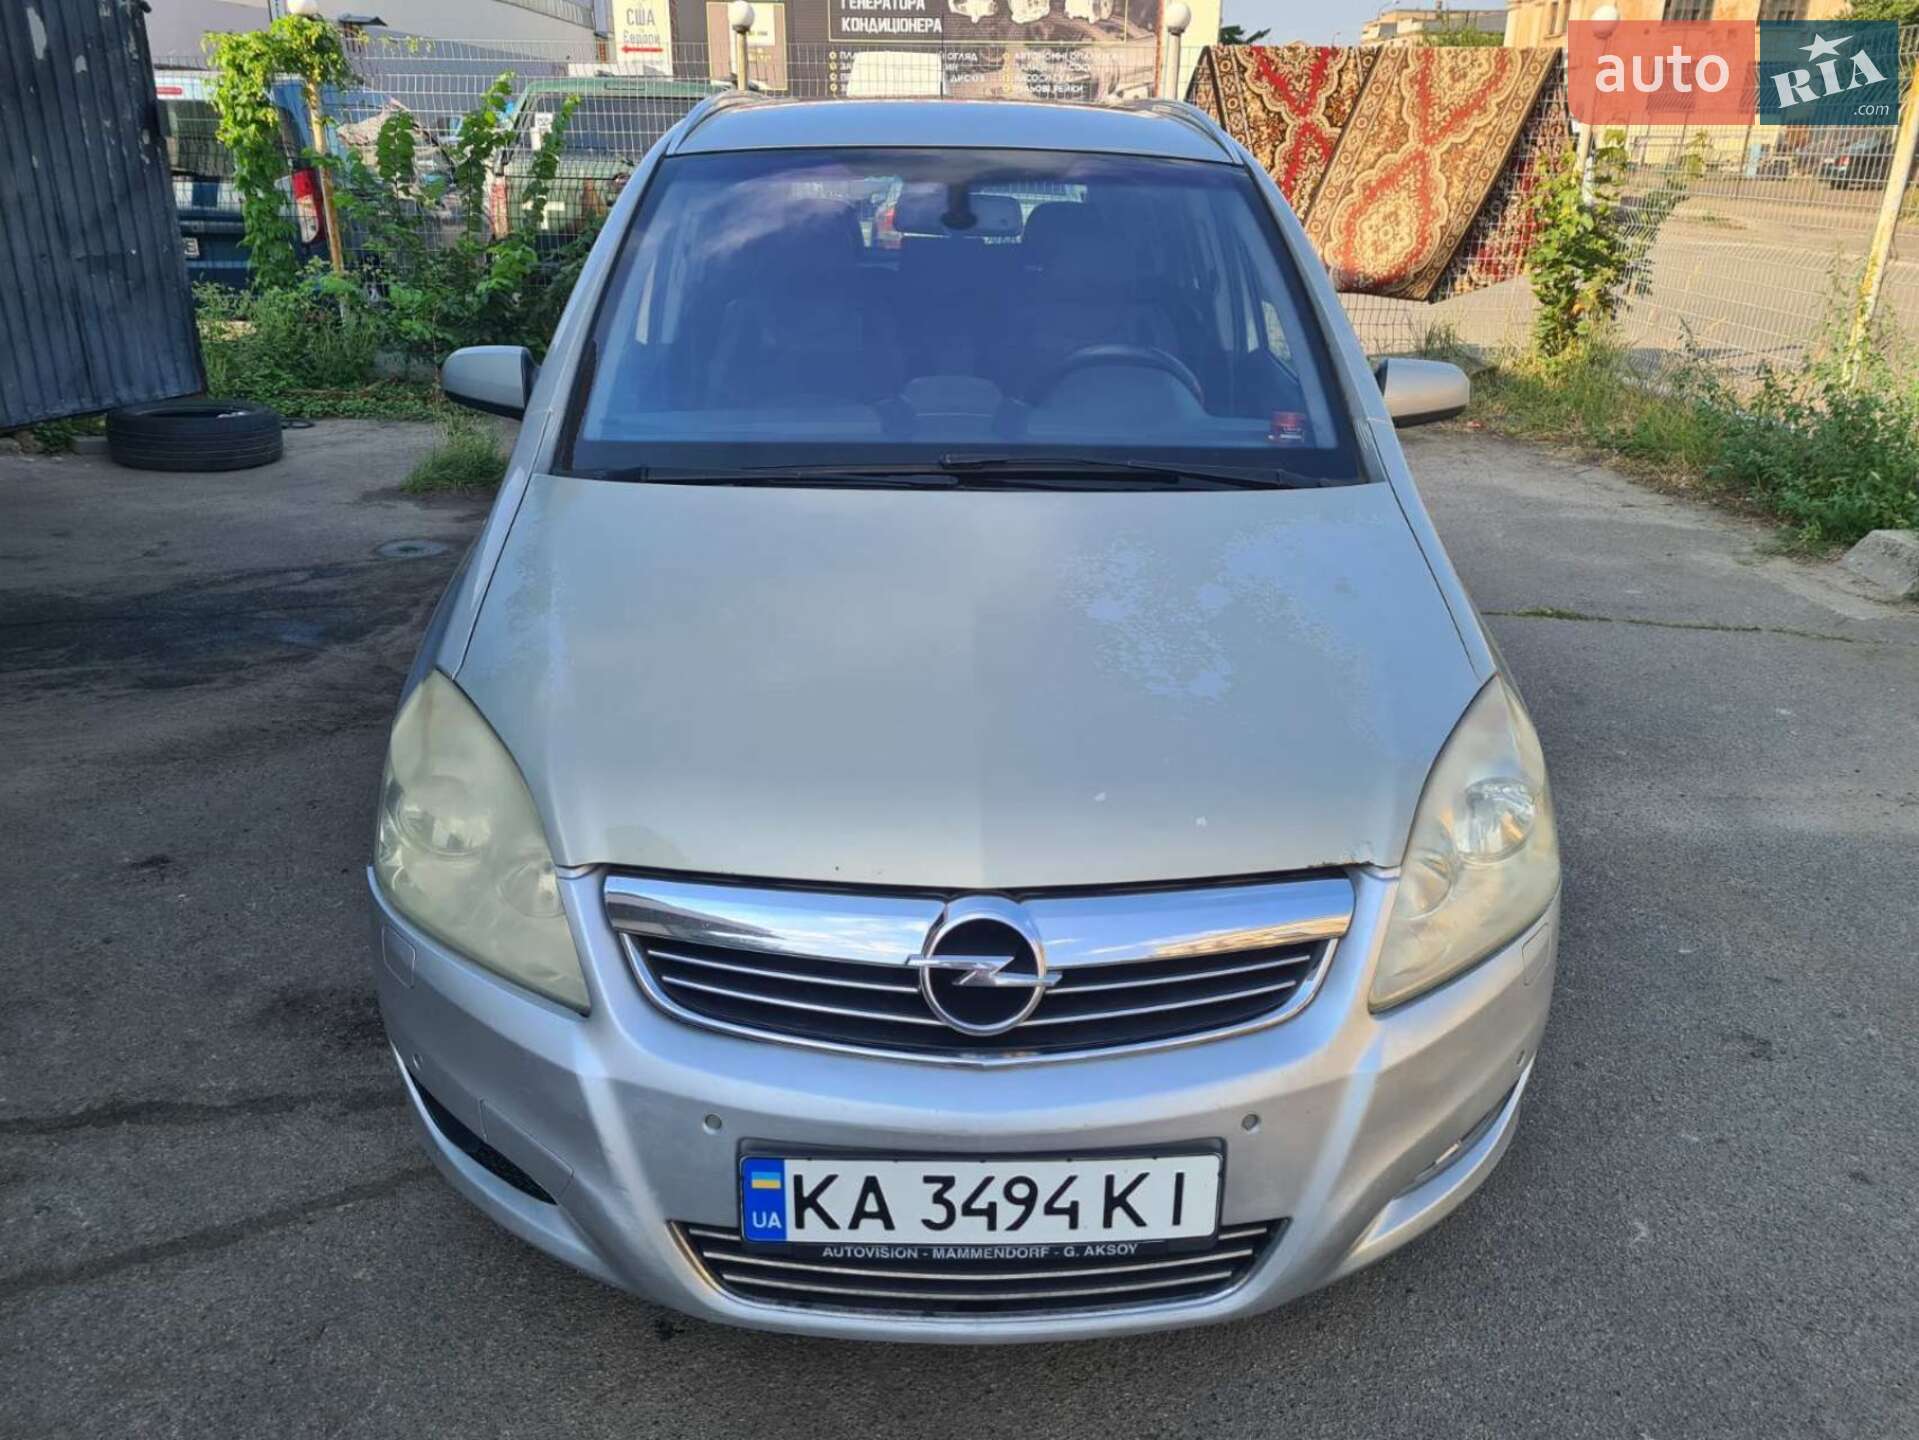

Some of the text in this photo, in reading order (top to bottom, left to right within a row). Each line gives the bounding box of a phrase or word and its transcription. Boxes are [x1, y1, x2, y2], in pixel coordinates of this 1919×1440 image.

[626, 8, 656, 26] США
[793, 1174, 896, 1231] KA
[921, 1175, 1080, 1231] 3494
[752, 1211, 782, 1229] UA
[822, 1247, 918, 1258] AUTOVISION
[932, 1247, 1049, 1259] MAMMENDORF
[1064, 1246, 1080, 1257] G.
[1084, 1244, 1138, 1256] AKSOY
